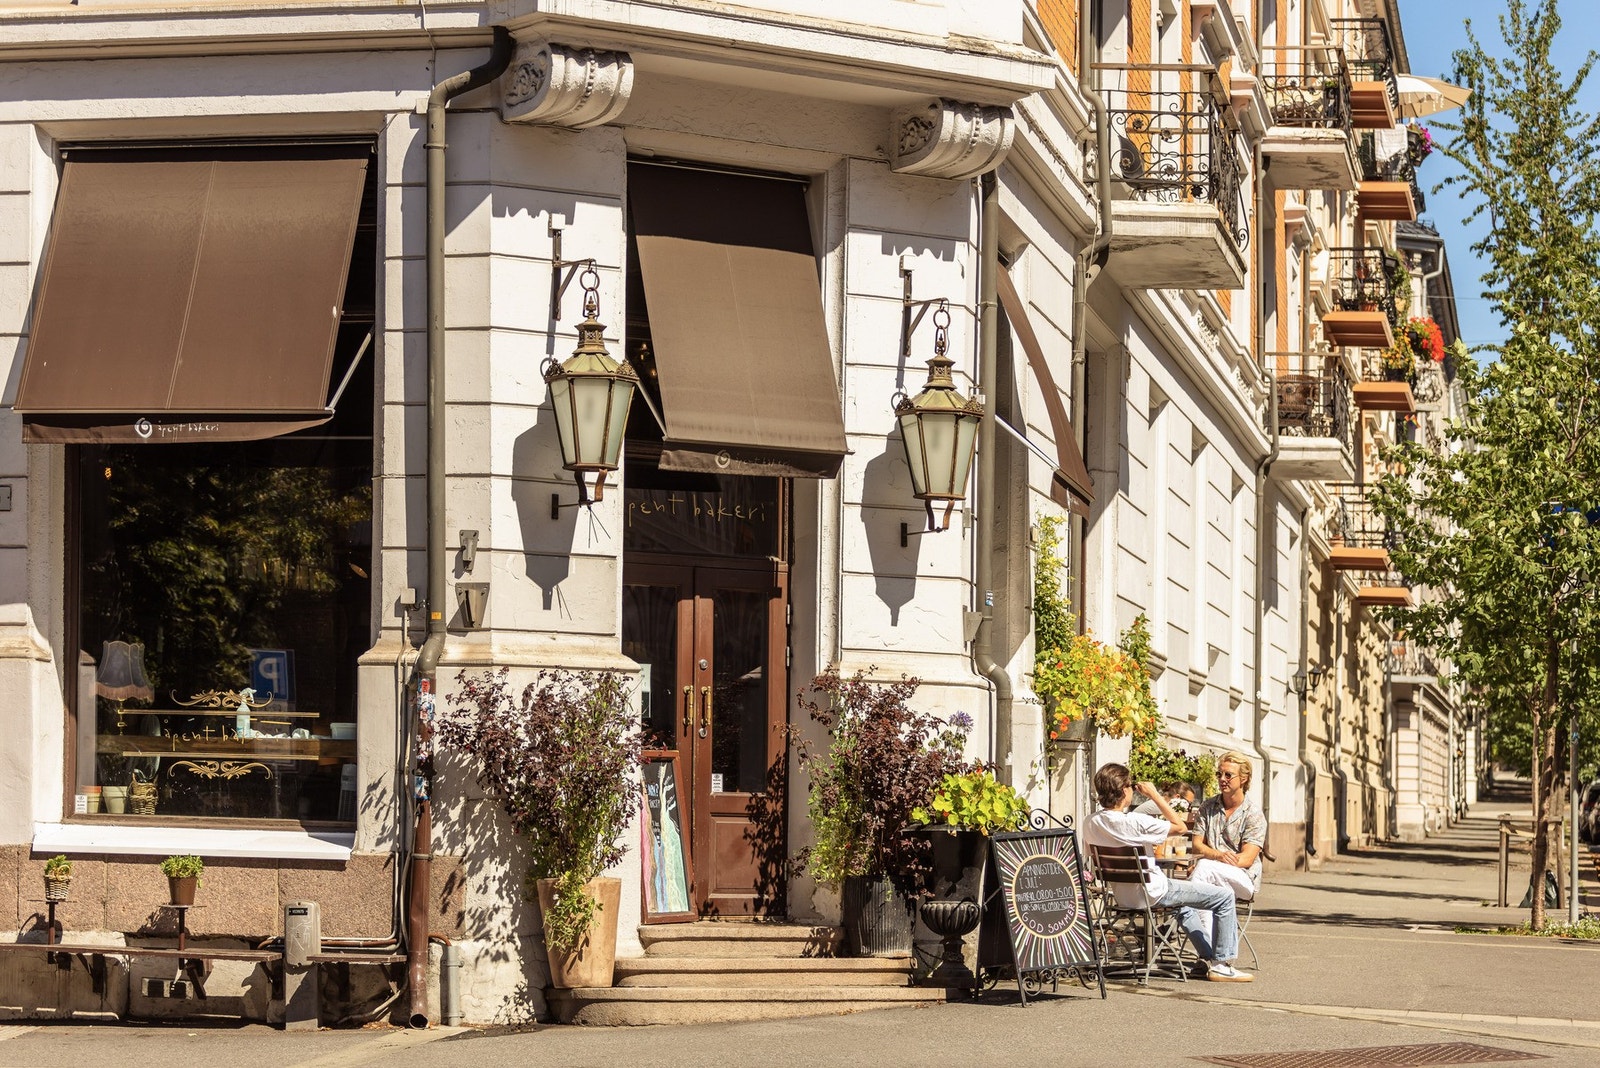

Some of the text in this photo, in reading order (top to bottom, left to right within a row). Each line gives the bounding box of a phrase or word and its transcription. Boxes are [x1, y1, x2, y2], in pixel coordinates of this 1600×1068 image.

[628, 493, 765, 528] pent bakeri
[163, 719, 216, 752] åpent
[1022, 912, 1044, 933] GOD
